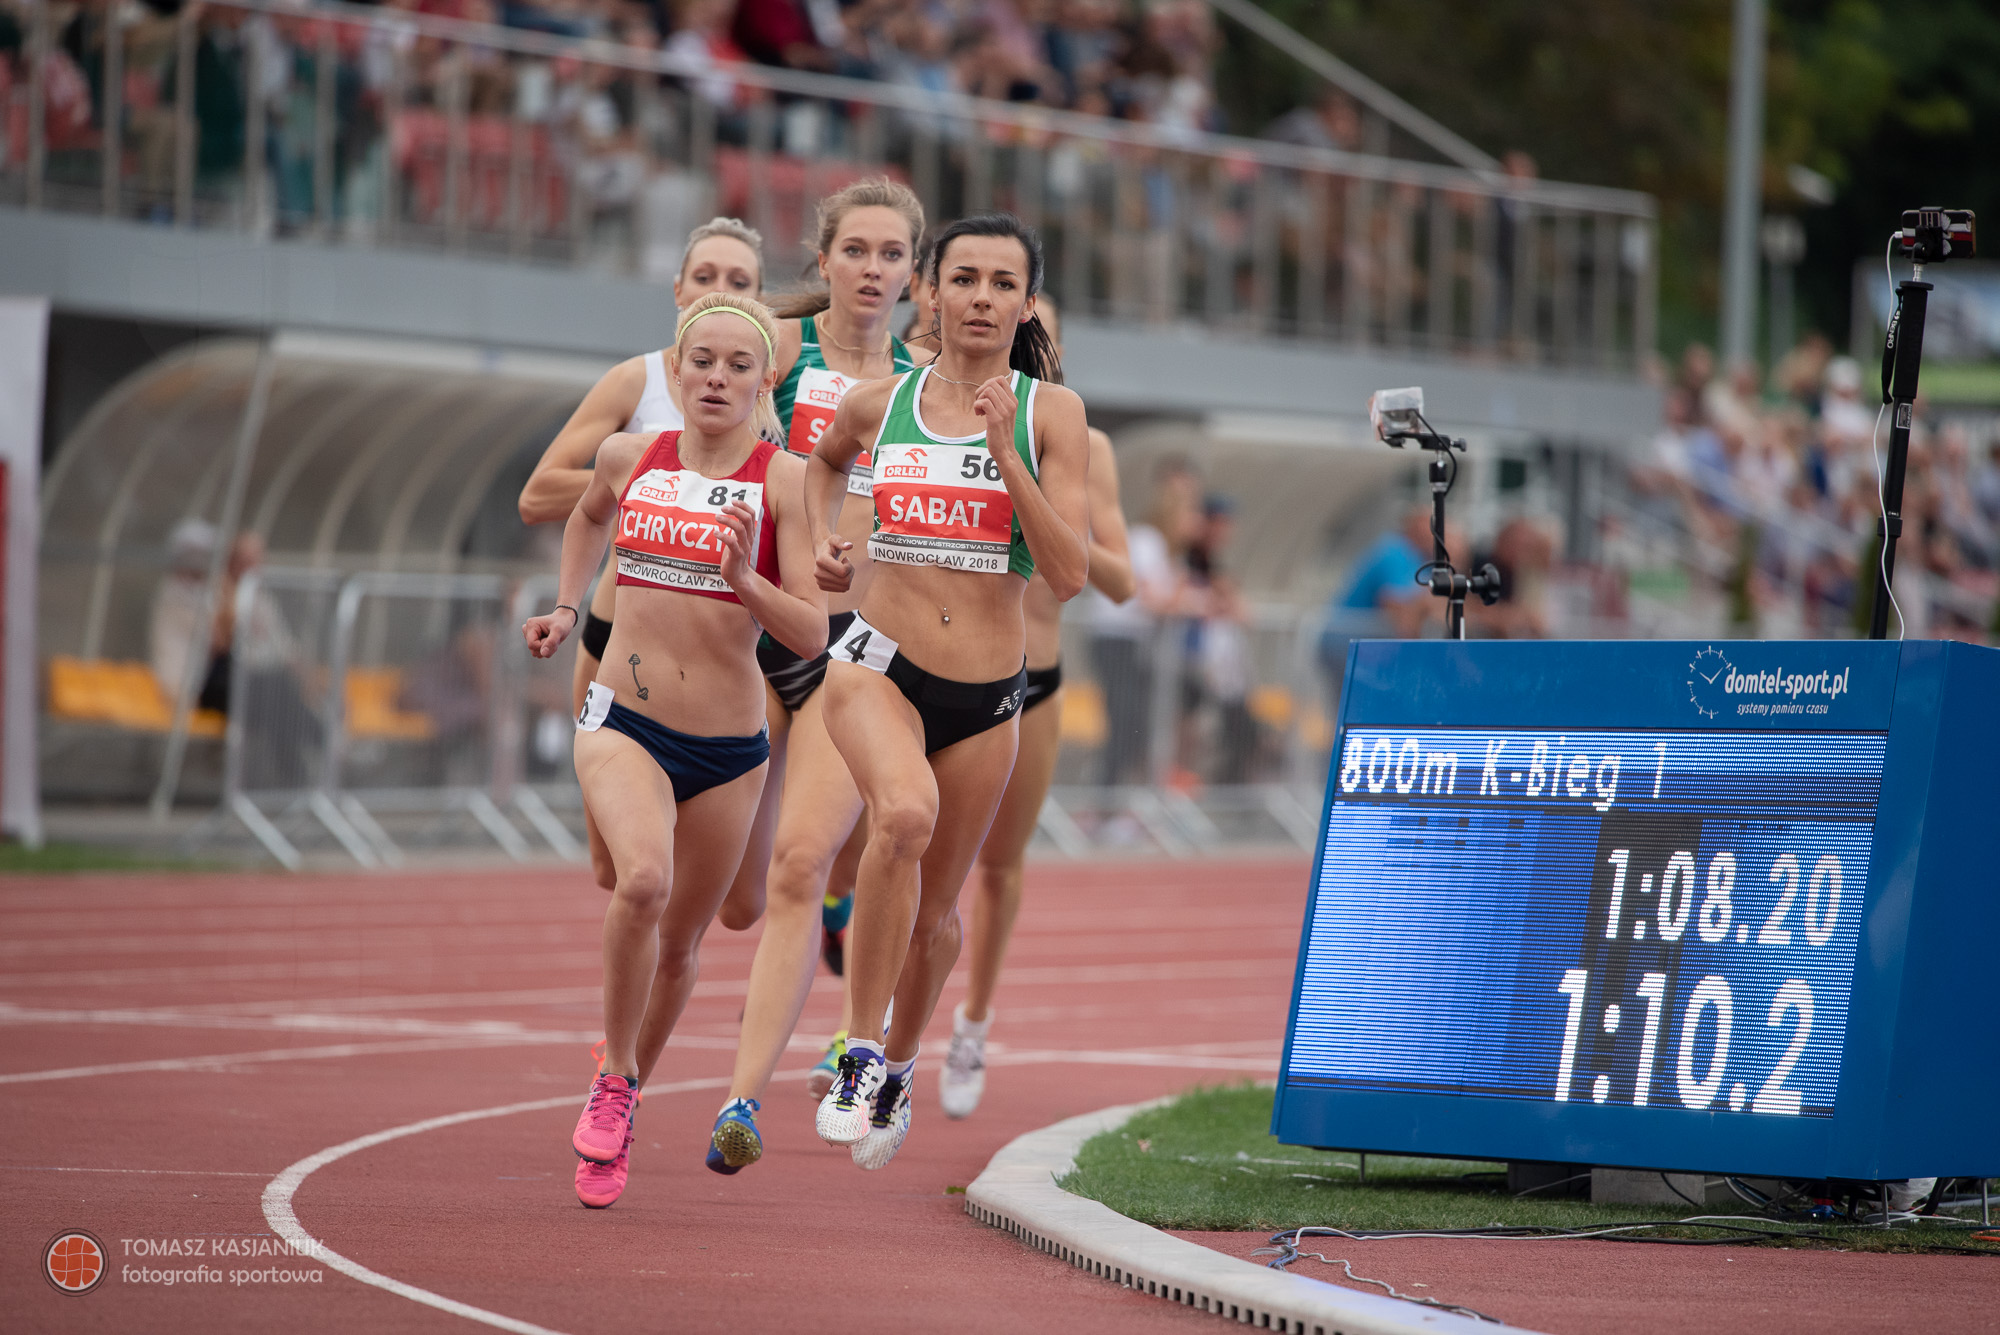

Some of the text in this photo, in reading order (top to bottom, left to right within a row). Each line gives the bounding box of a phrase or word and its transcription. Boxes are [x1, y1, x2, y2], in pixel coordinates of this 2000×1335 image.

[886, 466, 925, 478] ORLEN
[960, 454, 1003, 482] 56
[641, 487, 677, 502] ORLEN
[707, 486, 747, 506] 81
[889, 494, 988, 528] SABAT
[885, 536, 928, 546] DRUŻYNOWE
[929, 541, 982, 550] MISTRZOSTWA
[983, 545, 1008, 553] POLSKI
[874, 546, 998, 570] INOWROCŁAW 2018
[622, 562, 706, 586] INOWROCŁAW
[844, 629, 873, 663] 4
[1724, 666, 1850, 700] domtel-sport.pl
[1736, 701, 1829, 716] systemy pomiaru czasu
[1339, 736, 1668, 812] 800m K-Bieg 1
[1605, 848, 1845, 947] 1:08.20
[1555, 968, 1816, 1116] 1:10.2
